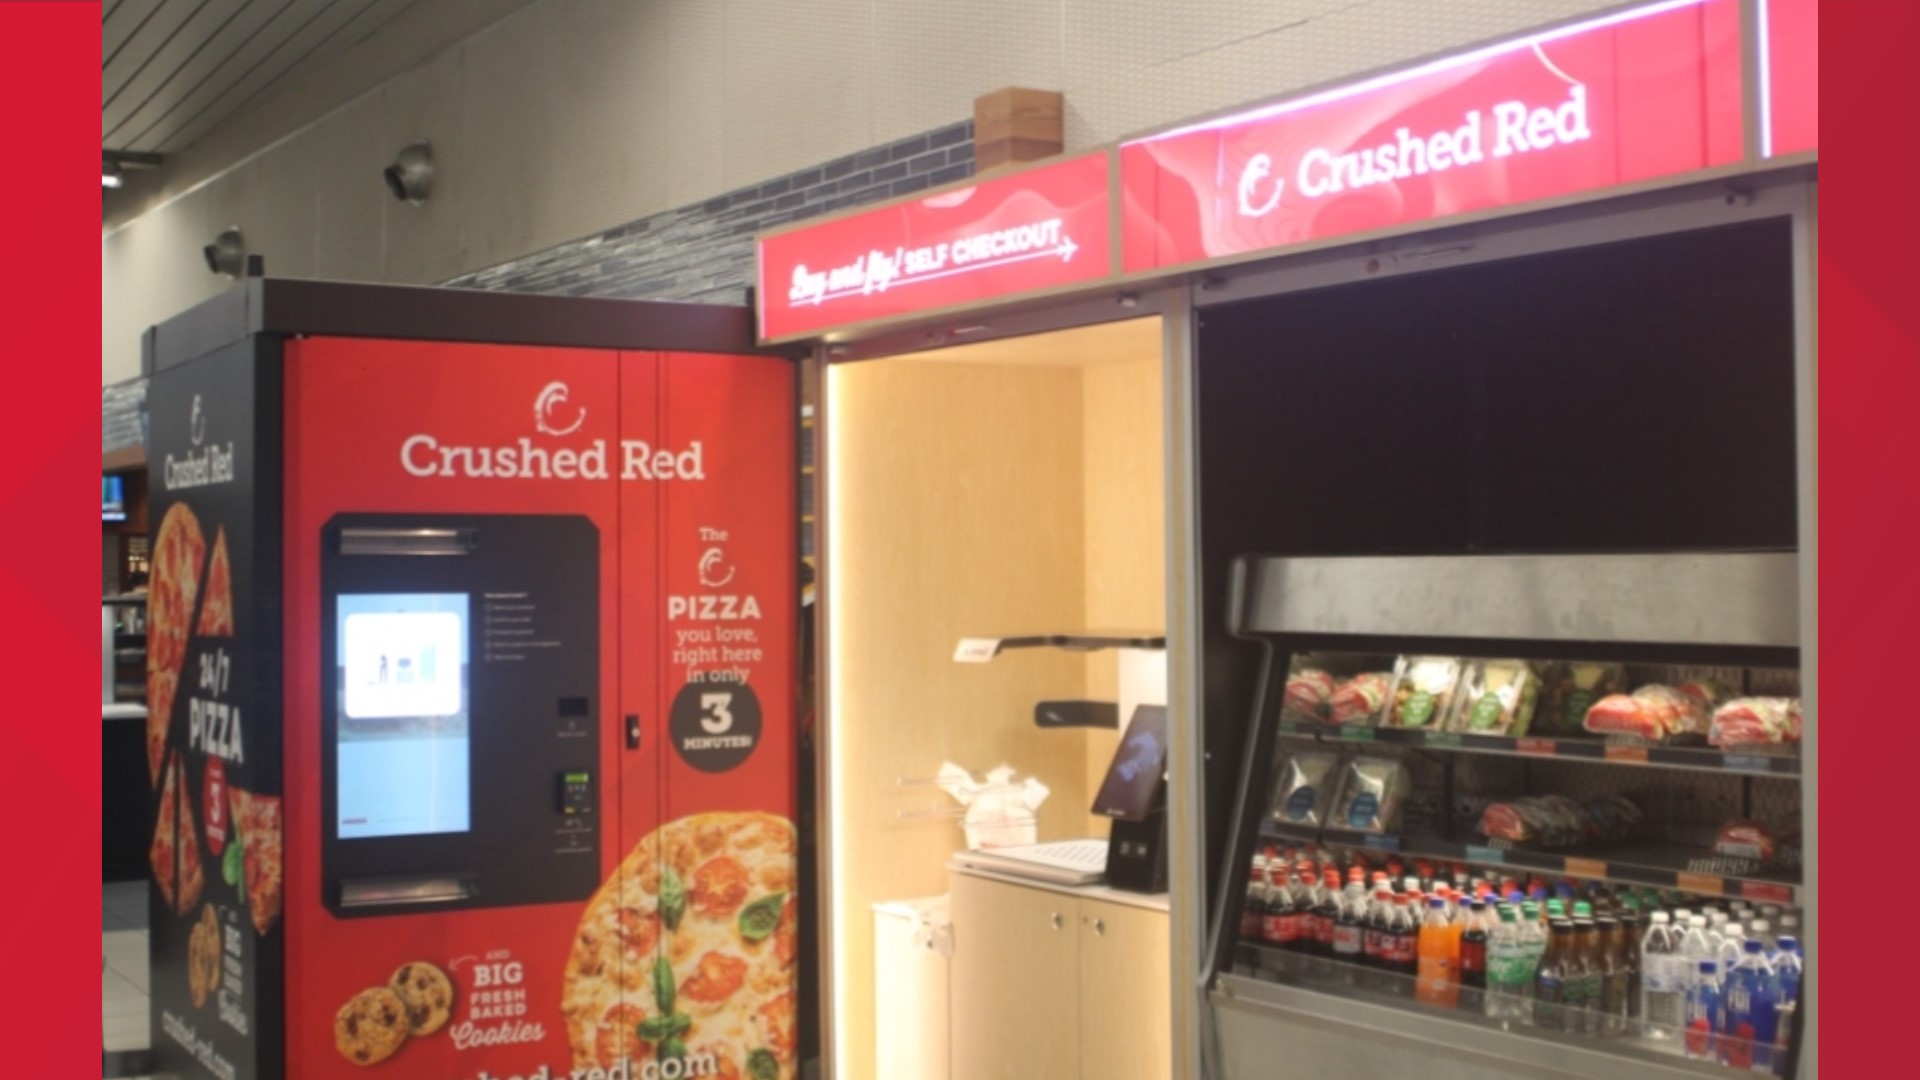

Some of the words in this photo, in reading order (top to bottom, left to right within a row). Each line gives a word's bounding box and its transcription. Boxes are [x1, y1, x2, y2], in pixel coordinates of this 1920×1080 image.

[1297, 110, 1484, 197] Crushed
[1492, 84, 1591, 157] Red
[788, 264, 827, 305] Buy
[904, 243, 949, 274] SELF
[950, 217, 1062, 265] CHECKOUT
[164, 446, 209, 491] Crushed
[401, 434, 609, 479] Crushed
[620, 440, 705, 480] Red
[699, 527, 728, 541] The
[668, 595, 762, 621] PIZZA
[676, 629, 711, 647] you
[715, 625, 758, 643] love,
[673, 646, 718, 667] right
[722, 646, 762, 661] here
[200, 648, 230, 697] 24/7
[686, 666, 706, 682] in
[709, 665, 750, 685] only
[700, 692, 733, 735] 3
[189, 697, 244, 764] PIZZA
[684, 736, 752, 750] MINUTES!
[473, 962, 523, 987] BIG
[470, 989, 526, 1005] FRESH
[470, 1002, 527, 1019] BAKED
[449, 1019, 547, 1051] Cookies
